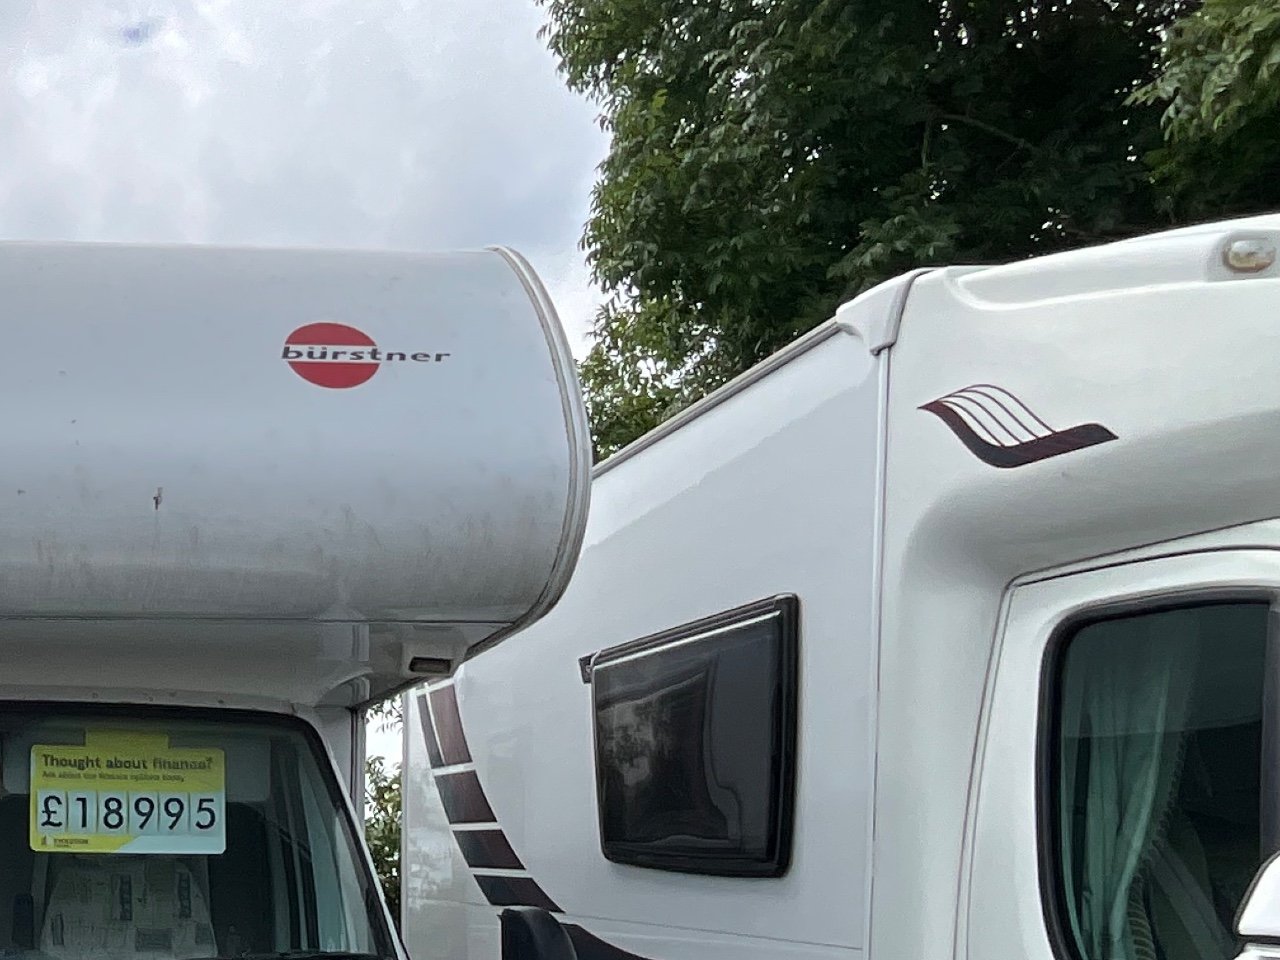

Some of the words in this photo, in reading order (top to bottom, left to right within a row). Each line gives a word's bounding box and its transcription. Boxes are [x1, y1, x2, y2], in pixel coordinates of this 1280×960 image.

[281, 346, 451, 362] bürstner
[42, 754, 101, 770] Thought
[106, 757, 148, 770] about
[41, 795, 216, 830] £18995
